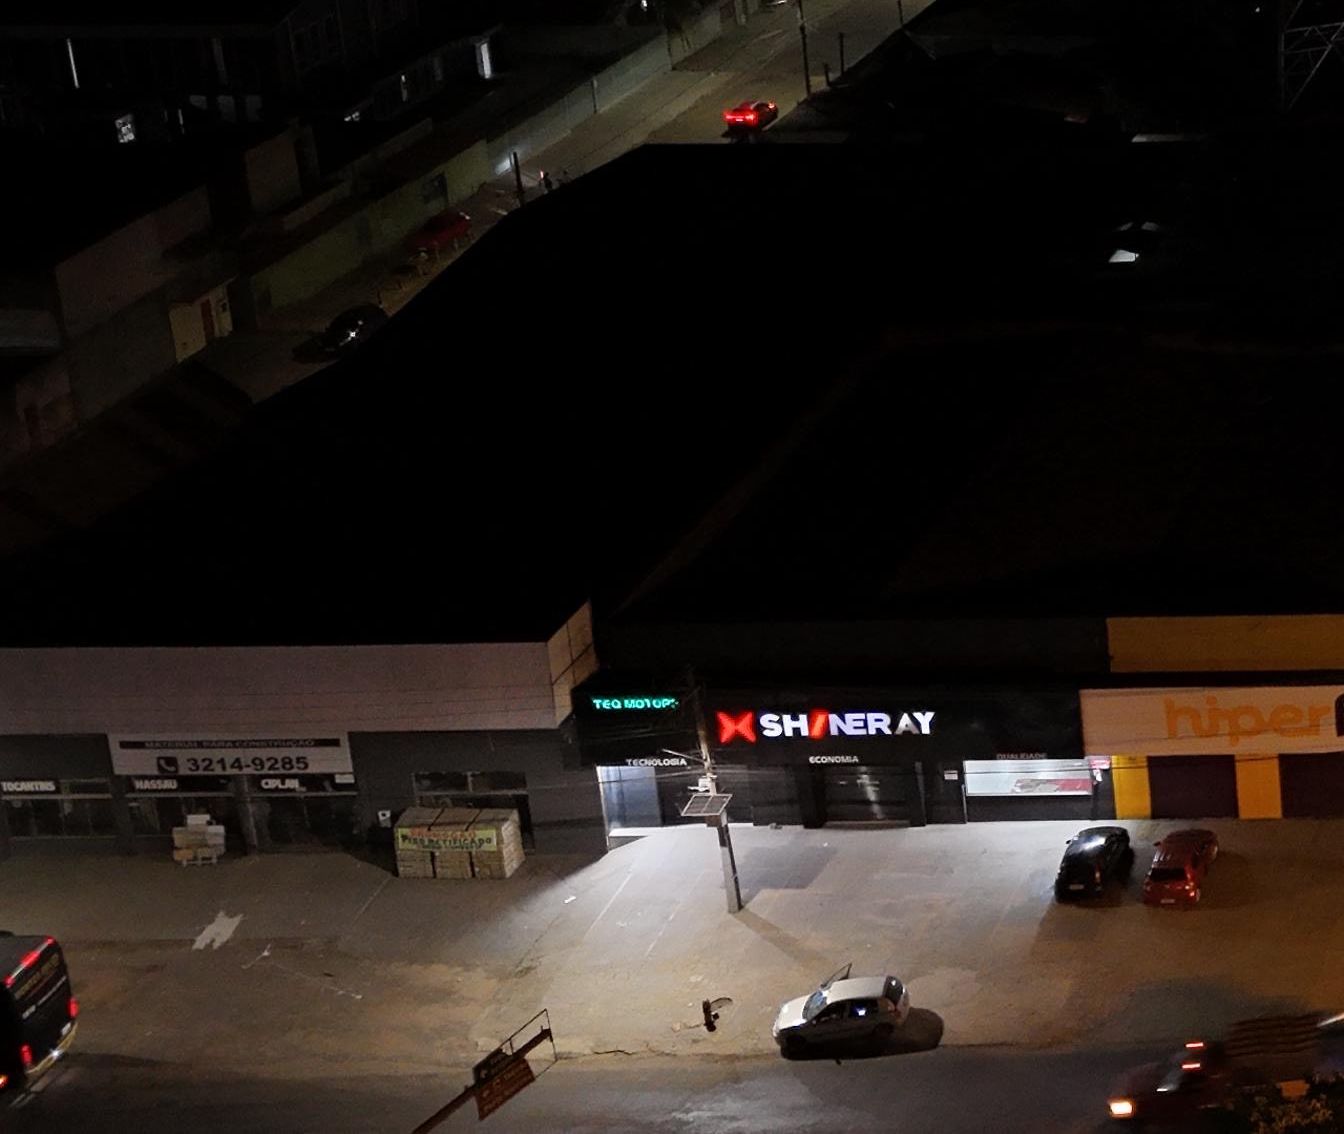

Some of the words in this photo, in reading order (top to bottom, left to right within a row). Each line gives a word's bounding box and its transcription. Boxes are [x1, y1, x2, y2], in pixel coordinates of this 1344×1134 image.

[759, 711, 935, 739] SHINERAY
[186, 756, 309, 772] 3214-9285
[625, 758, 688, 766] TECNOLOGIA
[809, 755, 859, 764] ECONOMIA
[0, 780, 57, 792] TOCANTINS
[134, 778, 179, 790] NASSAU
